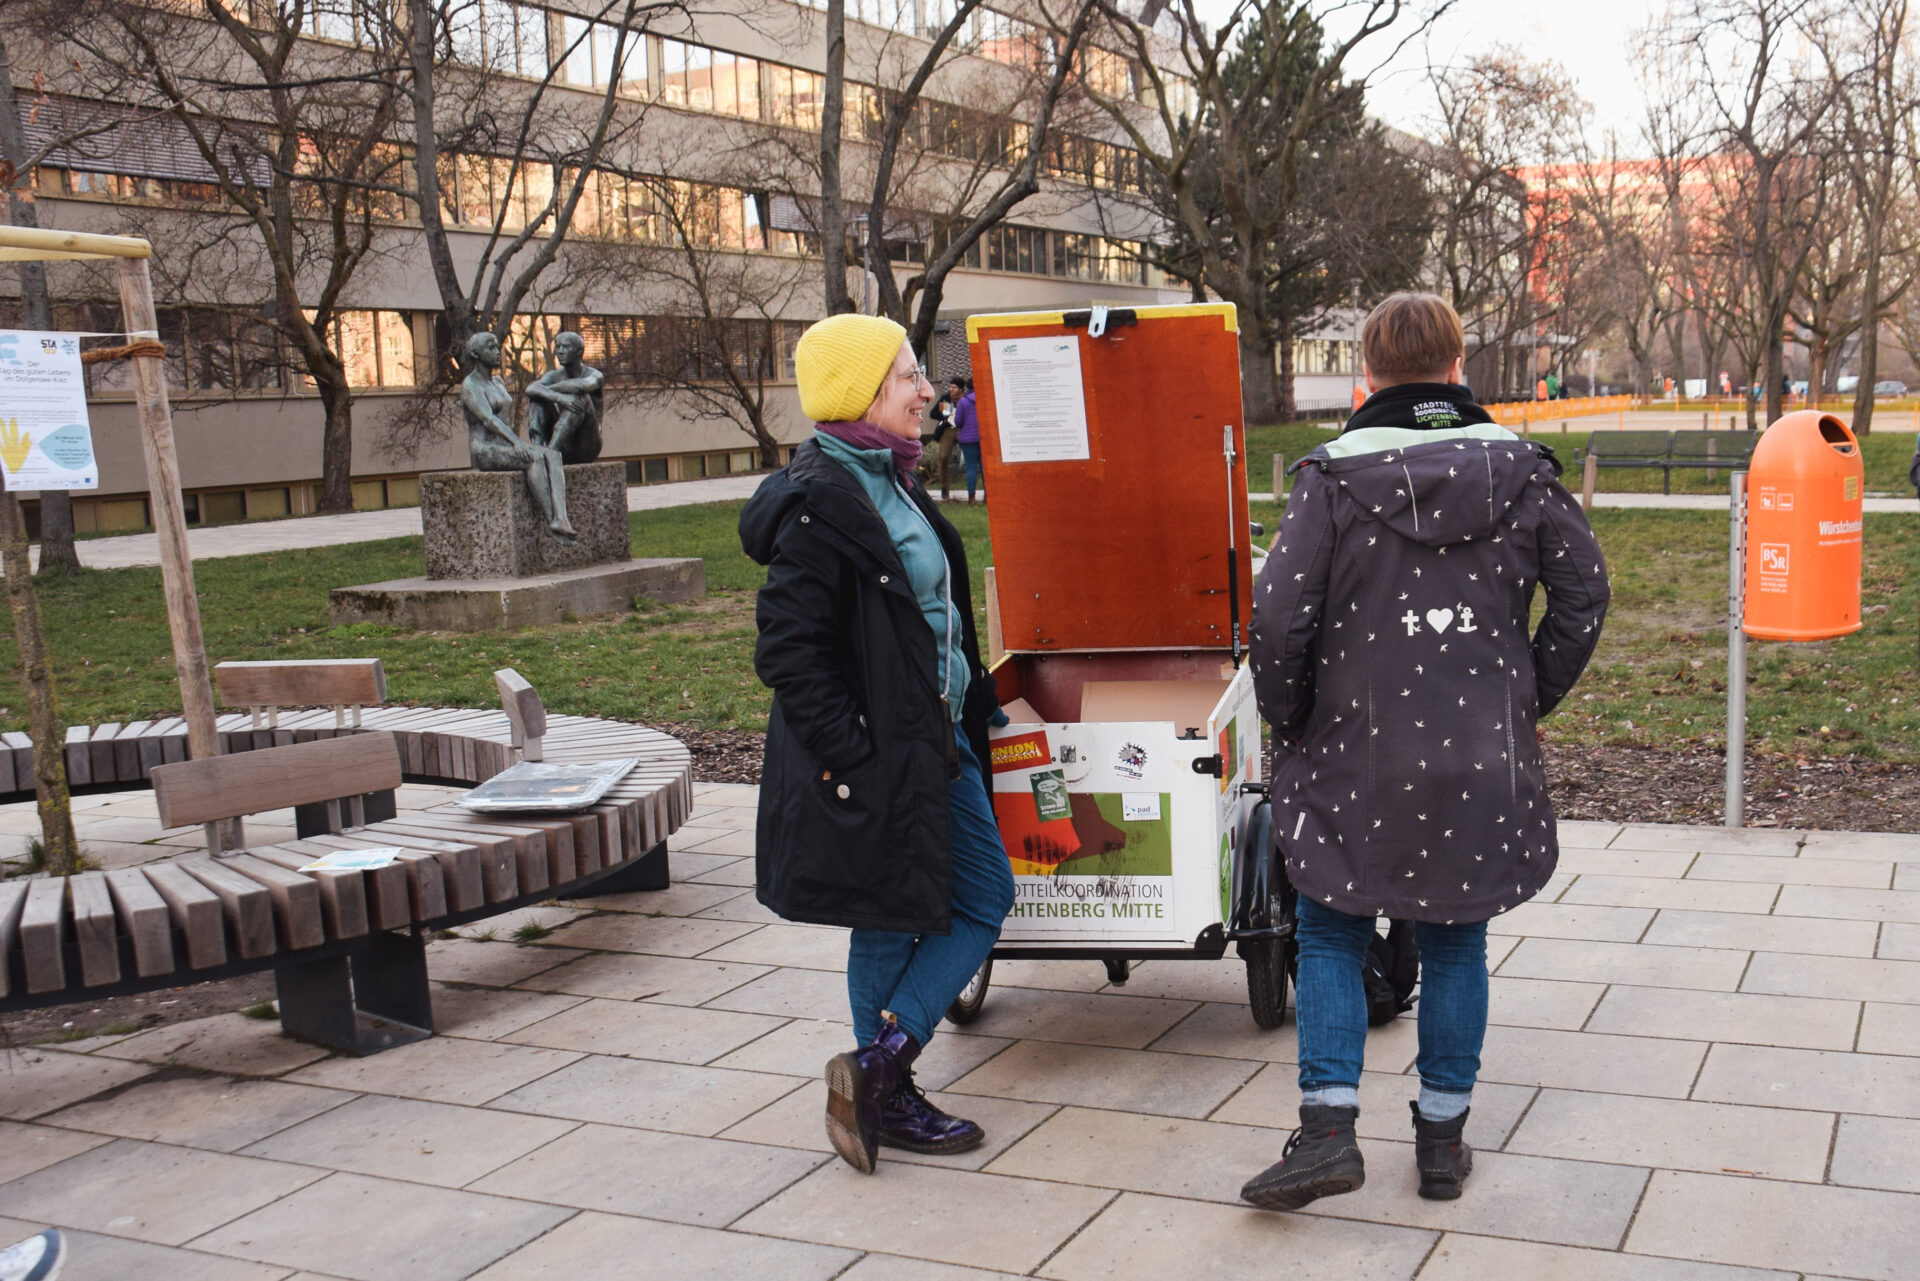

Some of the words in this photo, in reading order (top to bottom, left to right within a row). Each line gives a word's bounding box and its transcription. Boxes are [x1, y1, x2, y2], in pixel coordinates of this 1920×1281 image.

[40, 339, 57, 349] STA
[27, 360, 41, 368] Der
[12, 367, 26, 375] des
[1431, 420, 1452, 428] MITTE
[1763, 548, 1786, 569] BSR
[1137, 805, 1151, 814] pad
[1112, 903, 1164, 919] MITTE
